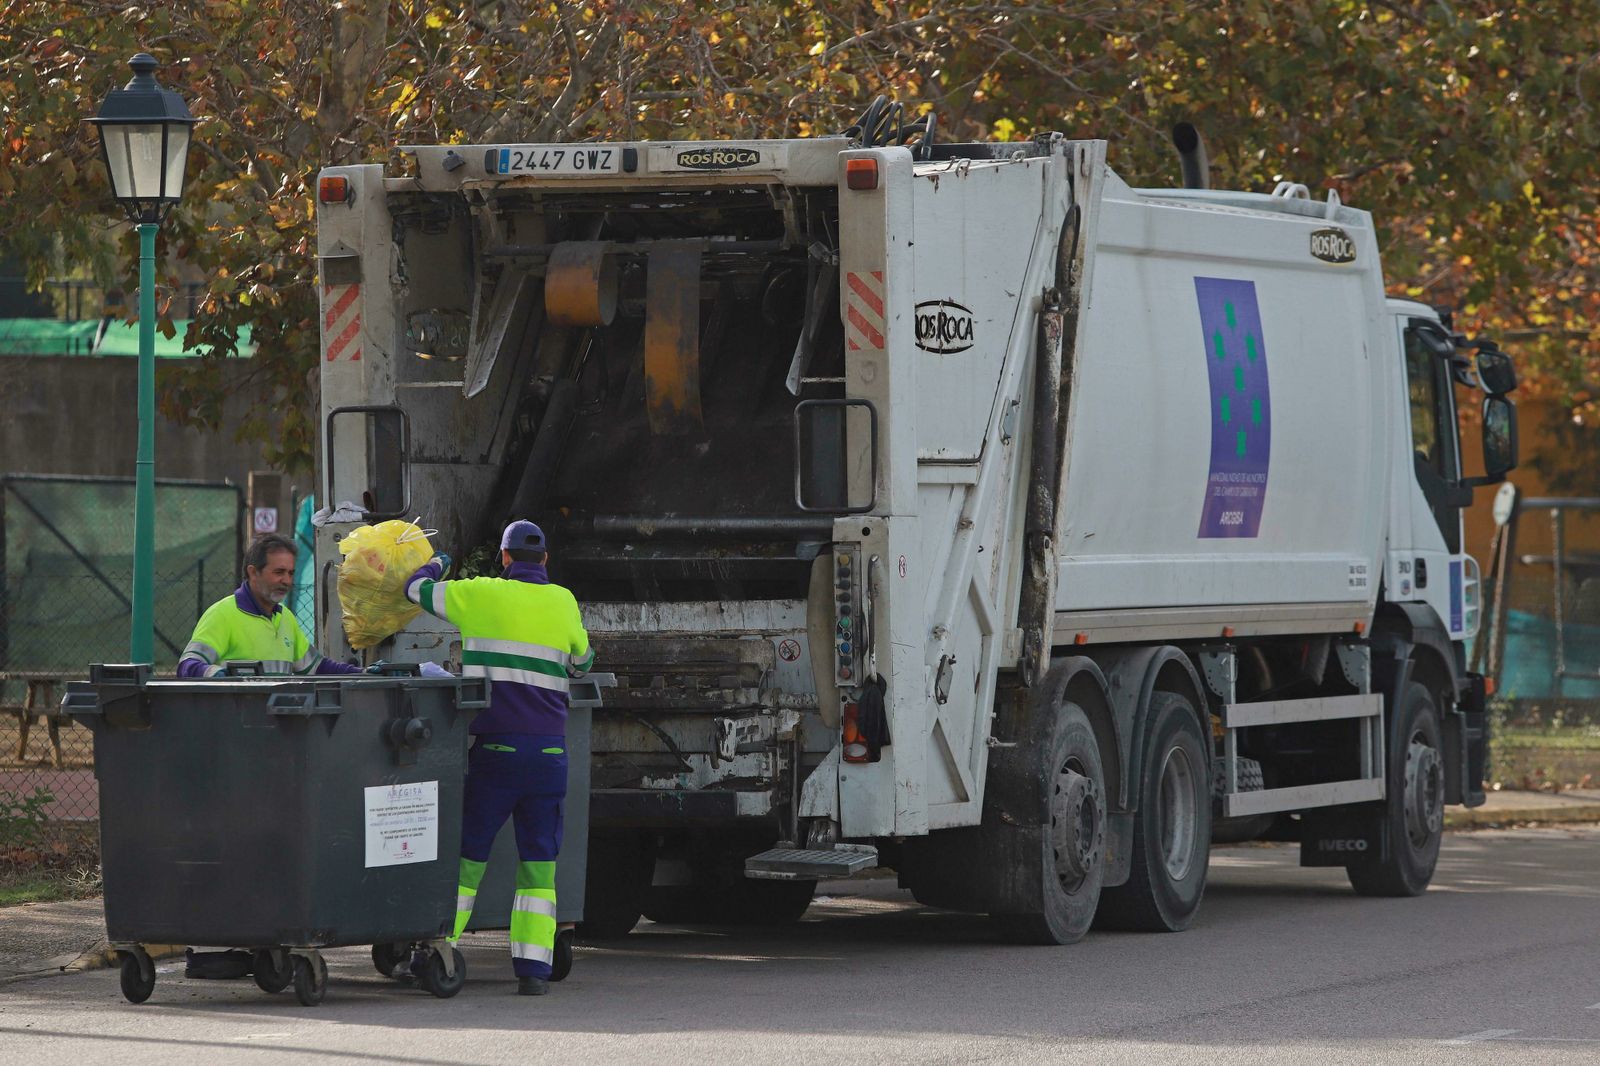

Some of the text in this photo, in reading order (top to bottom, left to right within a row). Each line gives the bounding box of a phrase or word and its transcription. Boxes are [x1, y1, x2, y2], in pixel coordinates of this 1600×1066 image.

[511, 150, 566, 171] 2447
[573, 150, 612, 170] GWZ
[1318, 839, 1368, 851] IVECO
